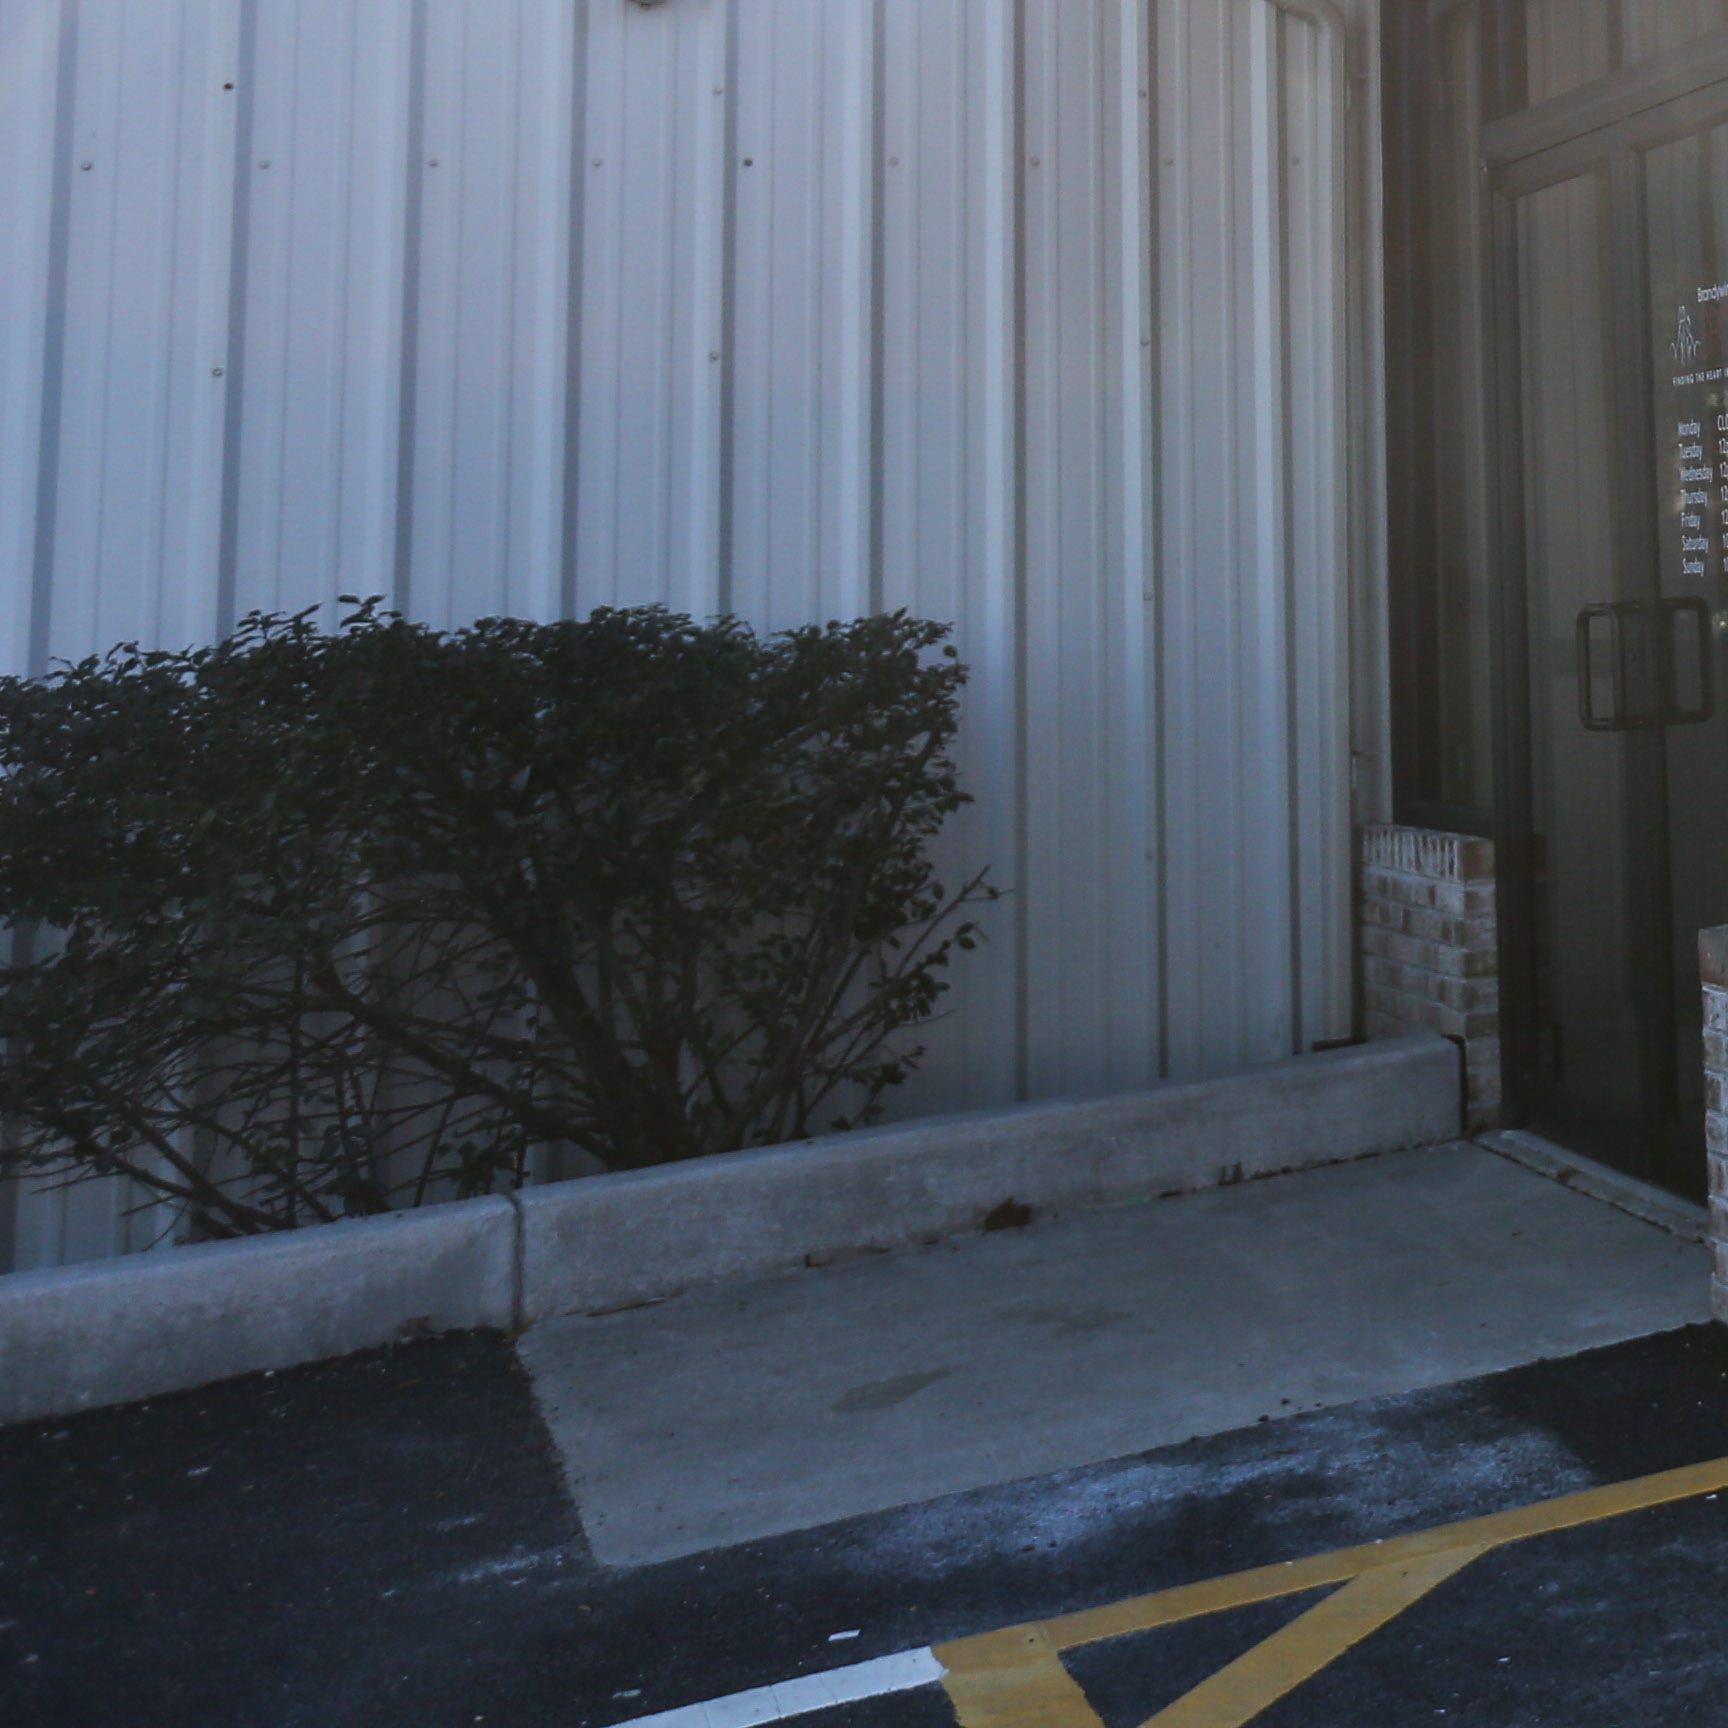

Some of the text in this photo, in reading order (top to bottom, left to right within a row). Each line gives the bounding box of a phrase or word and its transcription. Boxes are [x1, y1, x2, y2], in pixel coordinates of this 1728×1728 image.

[1672, 373, 1694, 386] FINDING
[1695, 371, 1705, 382] THE
[1706, 368, 1722, 381] HEART
[1678, 419, 1700, 438] Monday
[1678, 442, 1703, 461] Tuesday
[1680, 465, 1713, 483] Wednesday
[1680, 488, 1708, 507] Thursday
[1681, 512, 1700, 530] Friday
[1682, 535, 1709, 553] Saturday
[1683, 558, 1704, 576] Sunday
